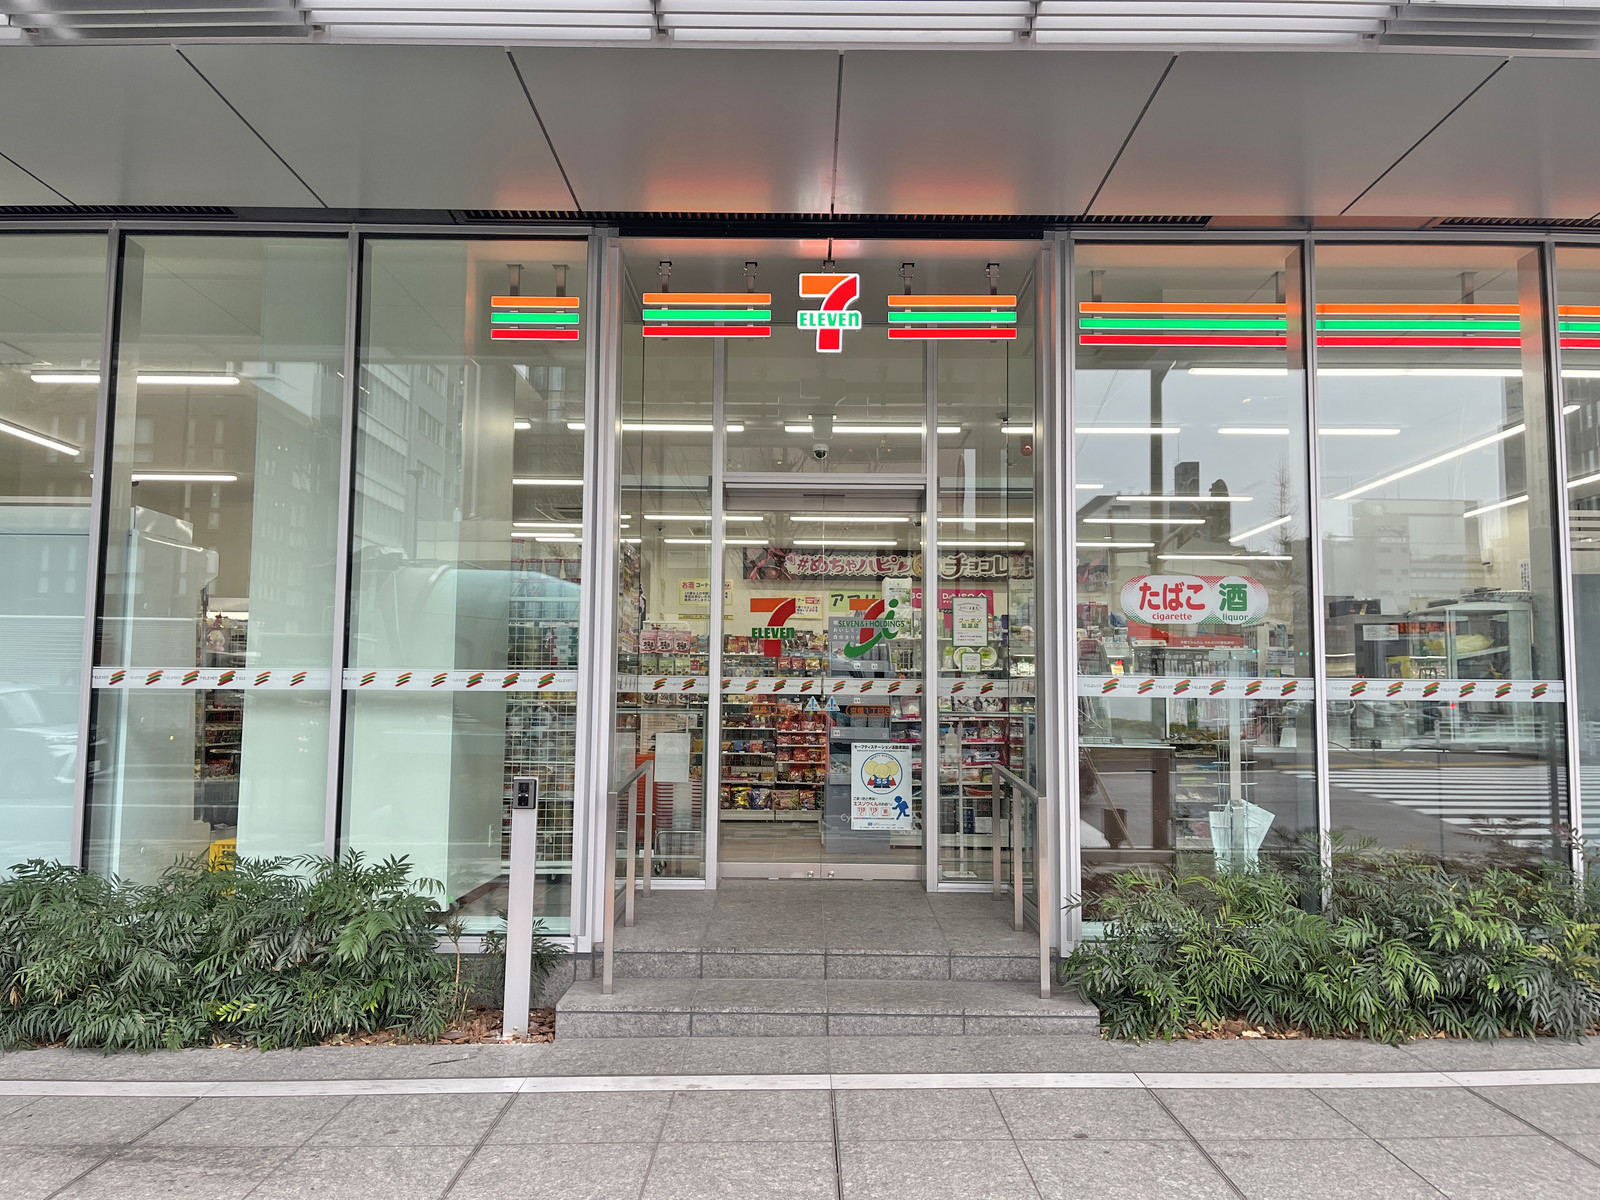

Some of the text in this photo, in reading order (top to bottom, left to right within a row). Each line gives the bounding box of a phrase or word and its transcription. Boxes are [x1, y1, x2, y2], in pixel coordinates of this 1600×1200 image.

[1139, 582, 1248, 612] たばこ 酒
[1152, 613, 1249, 622] cigarette liquor
[869, 620, 905, 628] HOLDINGS
